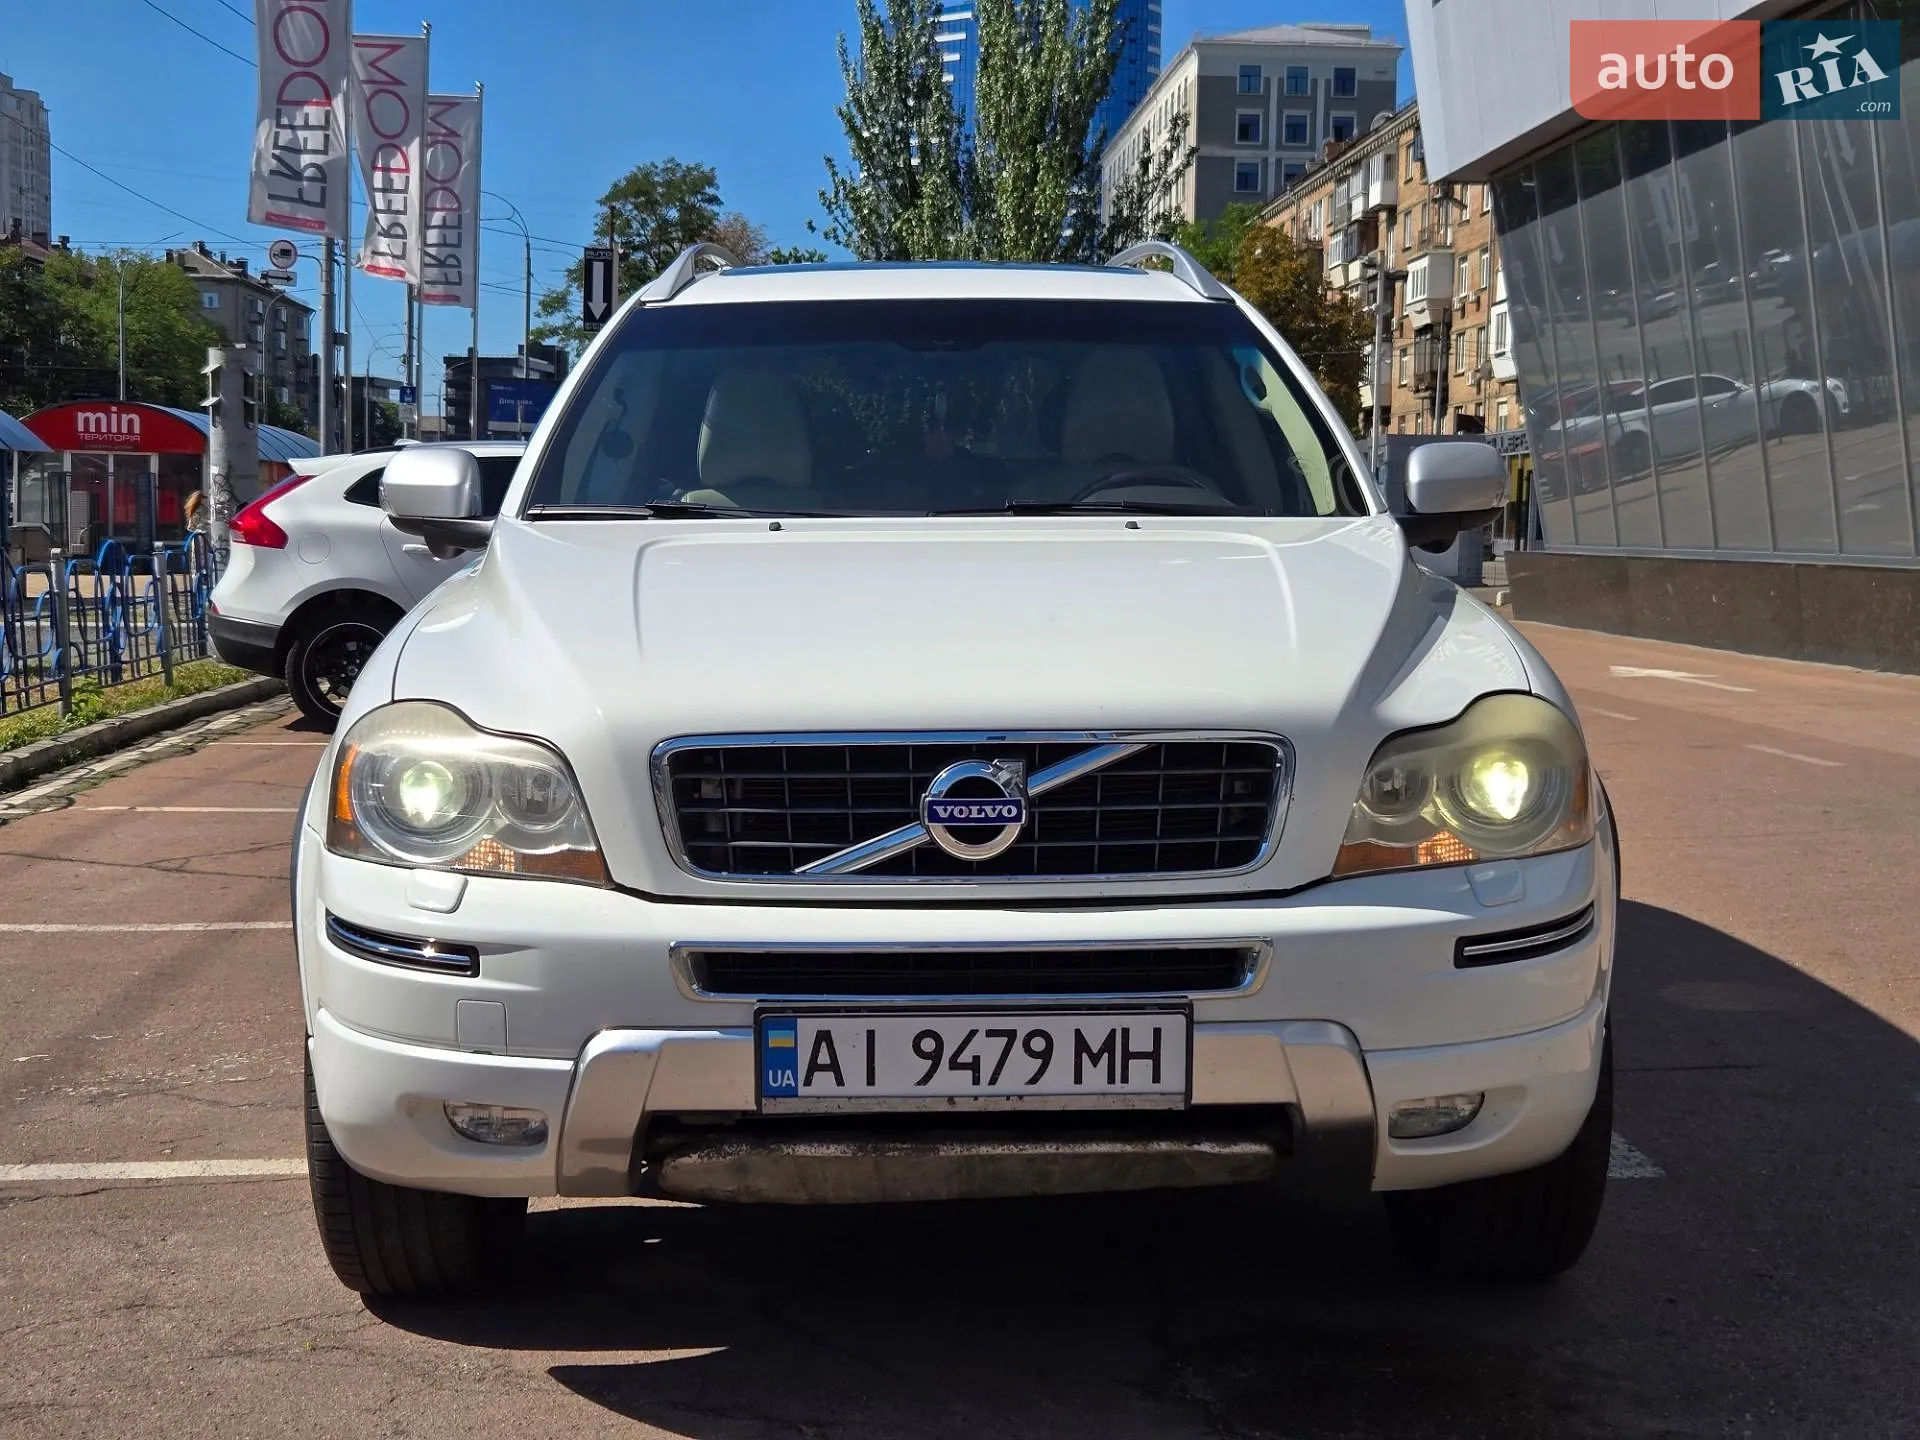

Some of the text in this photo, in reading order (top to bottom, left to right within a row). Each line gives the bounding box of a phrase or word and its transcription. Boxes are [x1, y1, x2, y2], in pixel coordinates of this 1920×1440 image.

[77, 406, 141, 434] min
[932, 804, 1019, 819] VOLVO
[911, 1028, 1055, 1087] 9479
[1073, 1027, 1162, 1086] MH
[768, 1069, 796, 1088] UA
